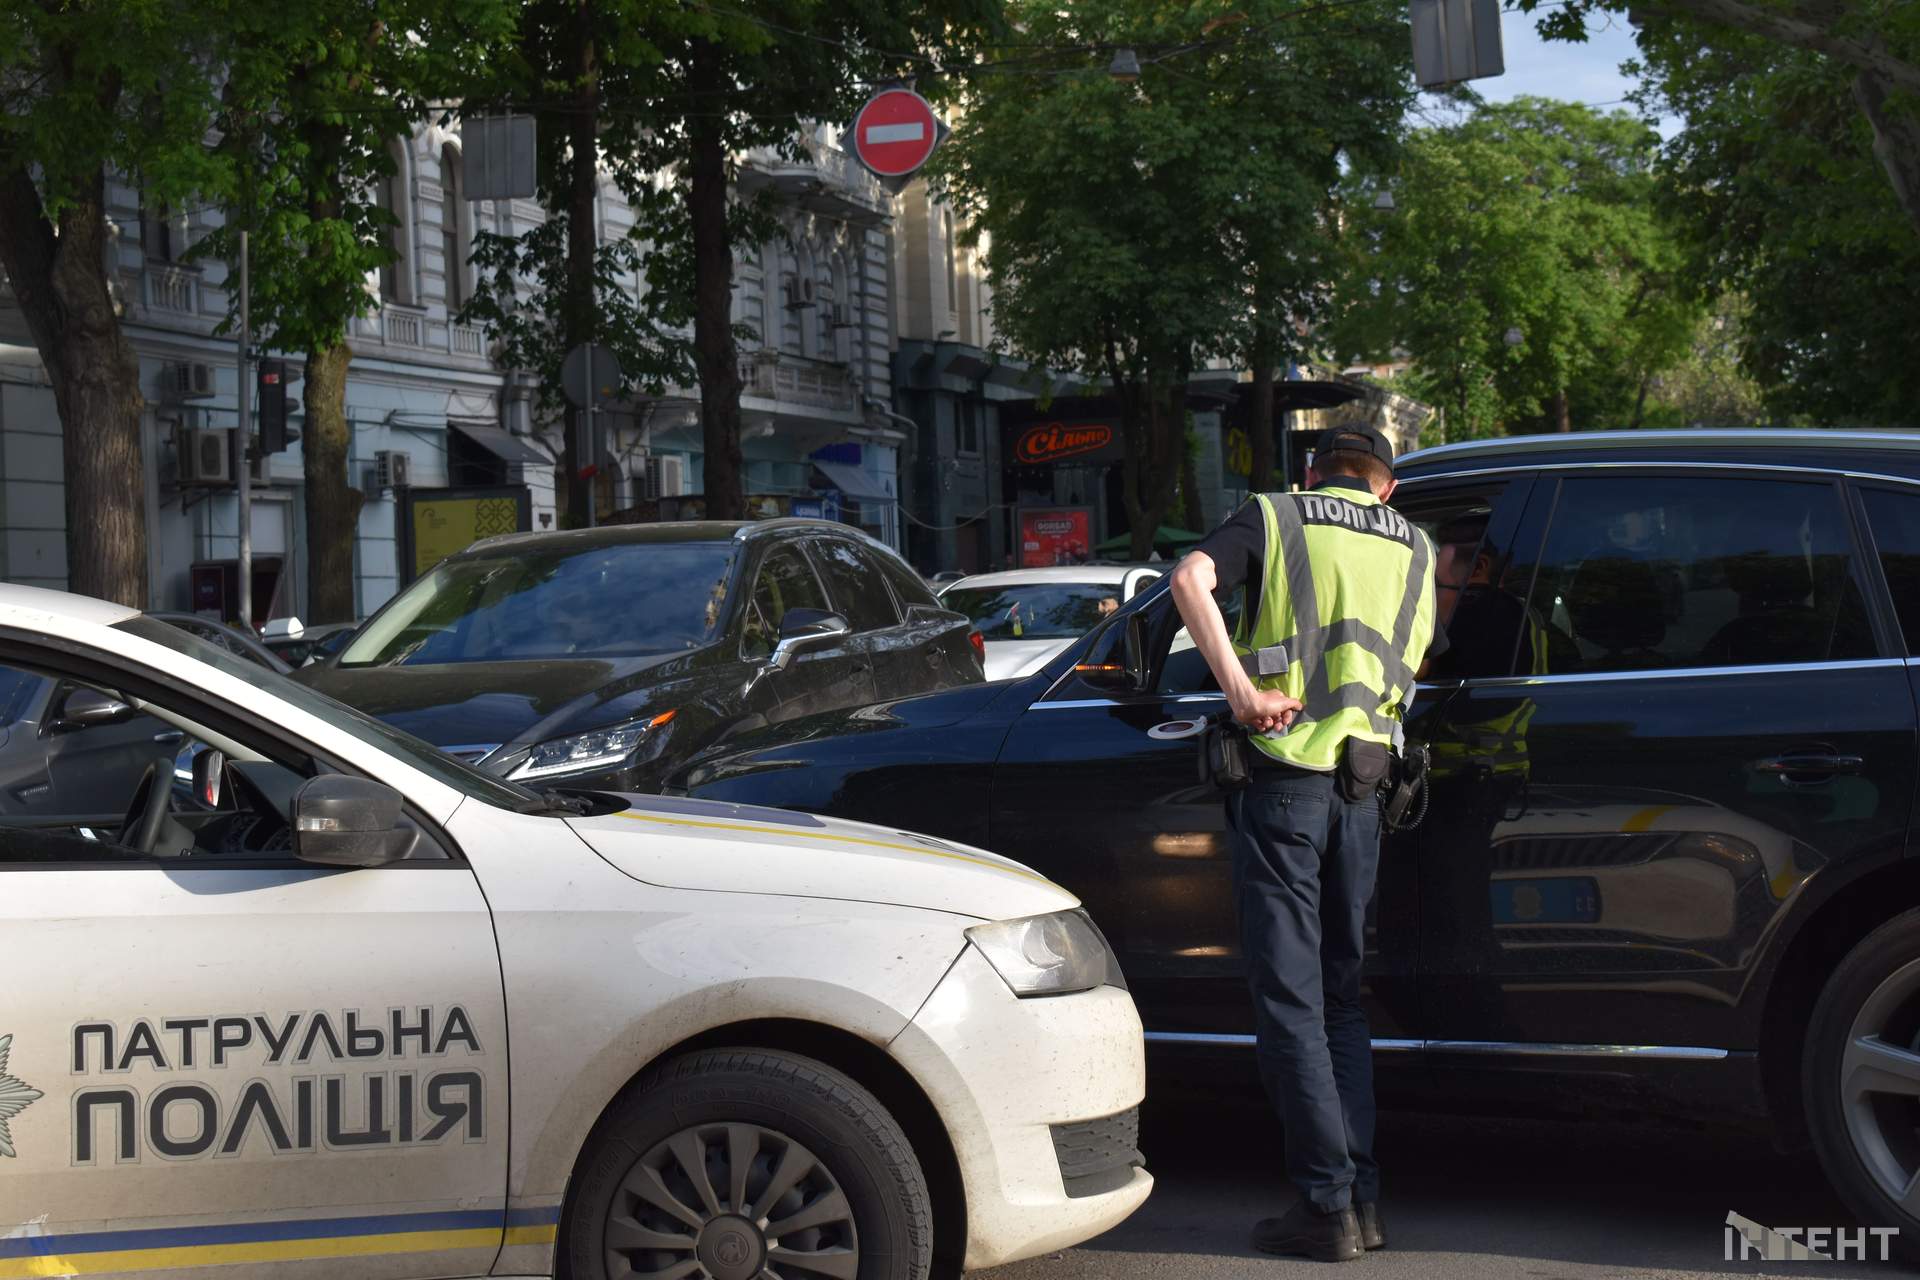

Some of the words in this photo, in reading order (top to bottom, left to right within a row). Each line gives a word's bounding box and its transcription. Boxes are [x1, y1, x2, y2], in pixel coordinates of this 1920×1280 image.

[1301, 495, 1411, 543] ПОЛІЦІЯ
[71, 1004, 484, 1075] ПАТРУЛЬНА
[72, 1069, 486, 1164] ПОЛІЦІЯ
